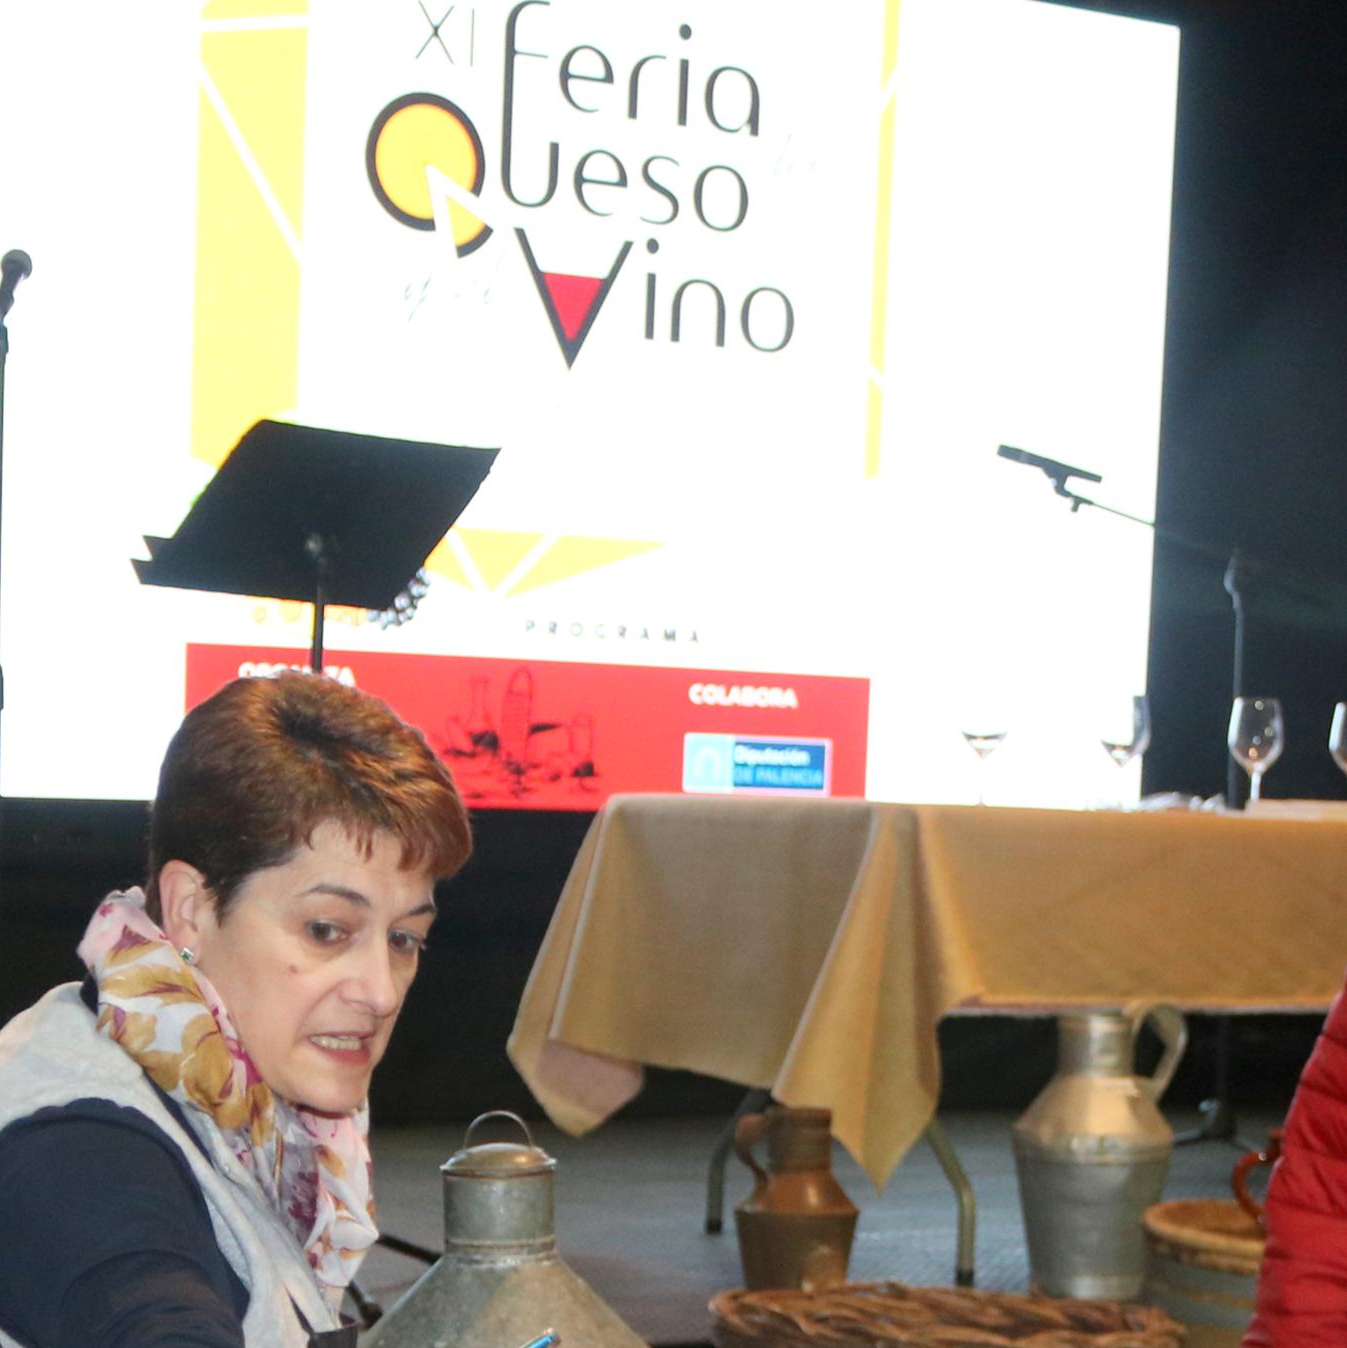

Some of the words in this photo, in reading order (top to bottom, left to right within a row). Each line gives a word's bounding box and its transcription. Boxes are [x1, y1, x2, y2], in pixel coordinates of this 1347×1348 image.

[415, 0, 475, 67] XI
[503, 0, 760, 137] Feria
[365, 91, 749, 258] Queso
[513, 226, 794, 370] Vino
[525, 619, 701, 643] PROGRAMA
[688, 682, 799, 709] COLABORA
[755, 767, 823, 788] PALENCIA
